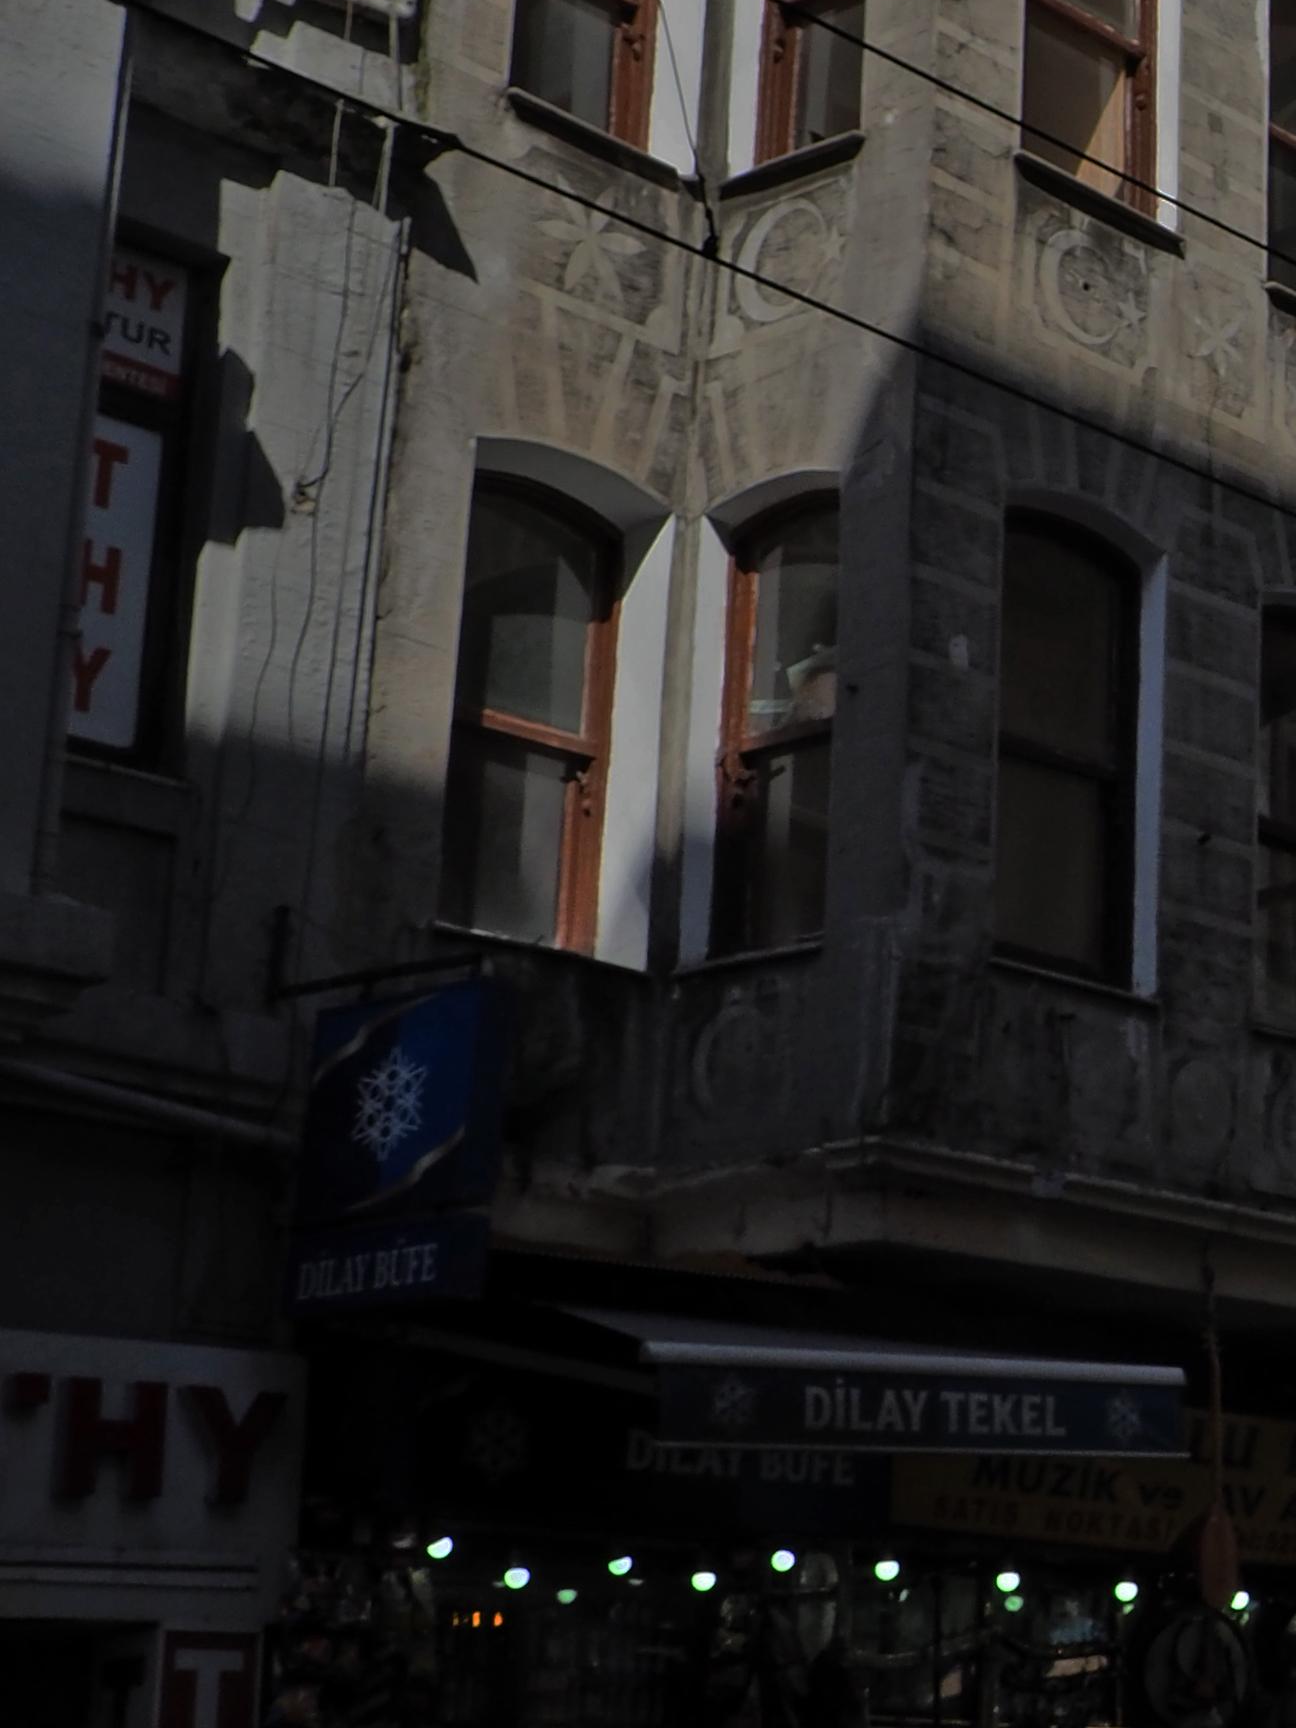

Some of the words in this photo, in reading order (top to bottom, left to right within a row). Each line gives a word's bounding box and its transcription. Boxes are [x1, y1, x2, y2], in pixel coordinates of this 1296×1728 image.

[296, 1247, 371, 1301] DİLAY
[372, 1235, 440, 1289] BÜFE
[4, 1372, 288, 1505] HY
[804, 1376, 928, 1434] DİLAY
[940, 1391, 1068, 1437] TEKEL
